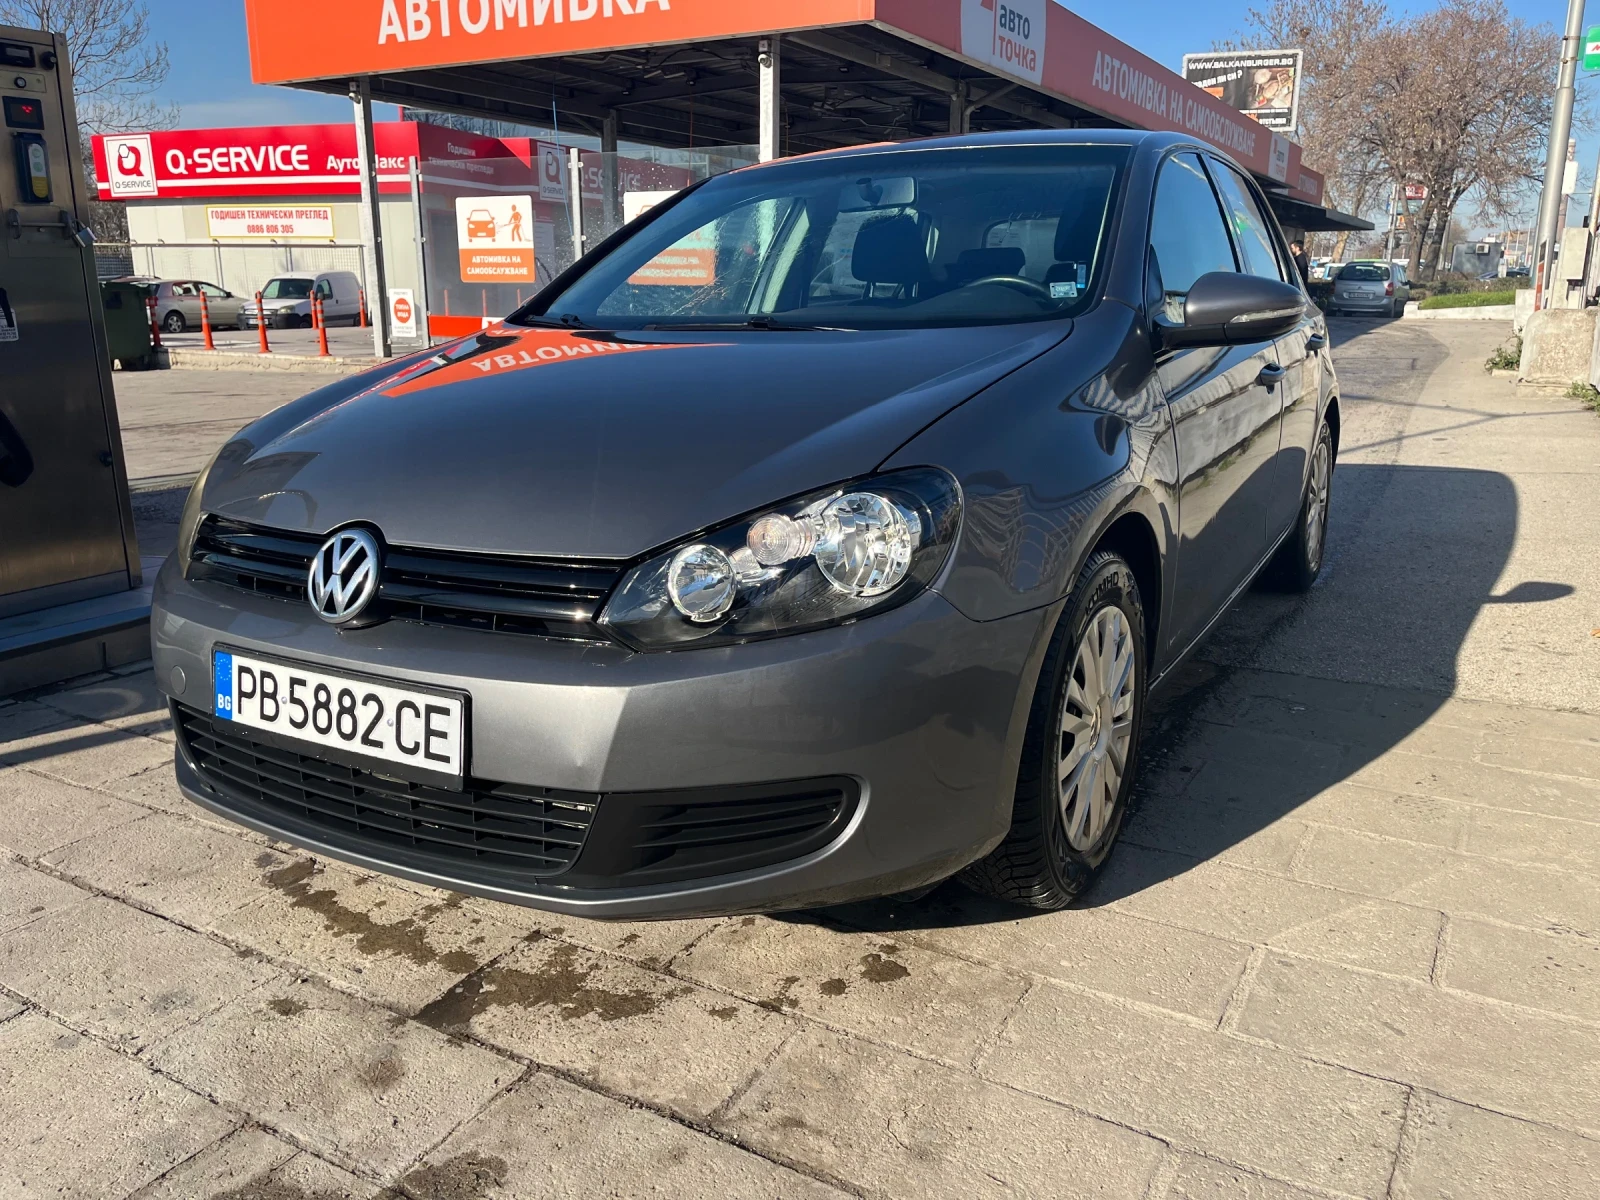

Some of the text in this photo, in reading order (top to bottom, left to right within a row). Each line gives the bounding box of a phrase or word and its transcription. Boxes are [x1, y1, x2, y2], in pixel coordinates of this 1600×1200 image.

[999, 4, 1030, 40] авто
[998, 35, 1037, 72] точка
[1188, 58, 1294, 70] WWW.BALKANBURGER.BG
[1092, 50, 1256, 157] АВТОМИВКА НА САМООБСЛУЖВАНЕ
[211, 209, 329, 221] ГОДИШЕН ТЕХНИЧЕСКИ ПРЕГЛЕД
[247, 224, 294, 234] 0886 806 305
[472, 255, 521, 263] АВТОМИВКА НА
[466, 266, 529, 276] САМООБСЛУЖВАНЕ
[217, 693, 232, 710] BG
